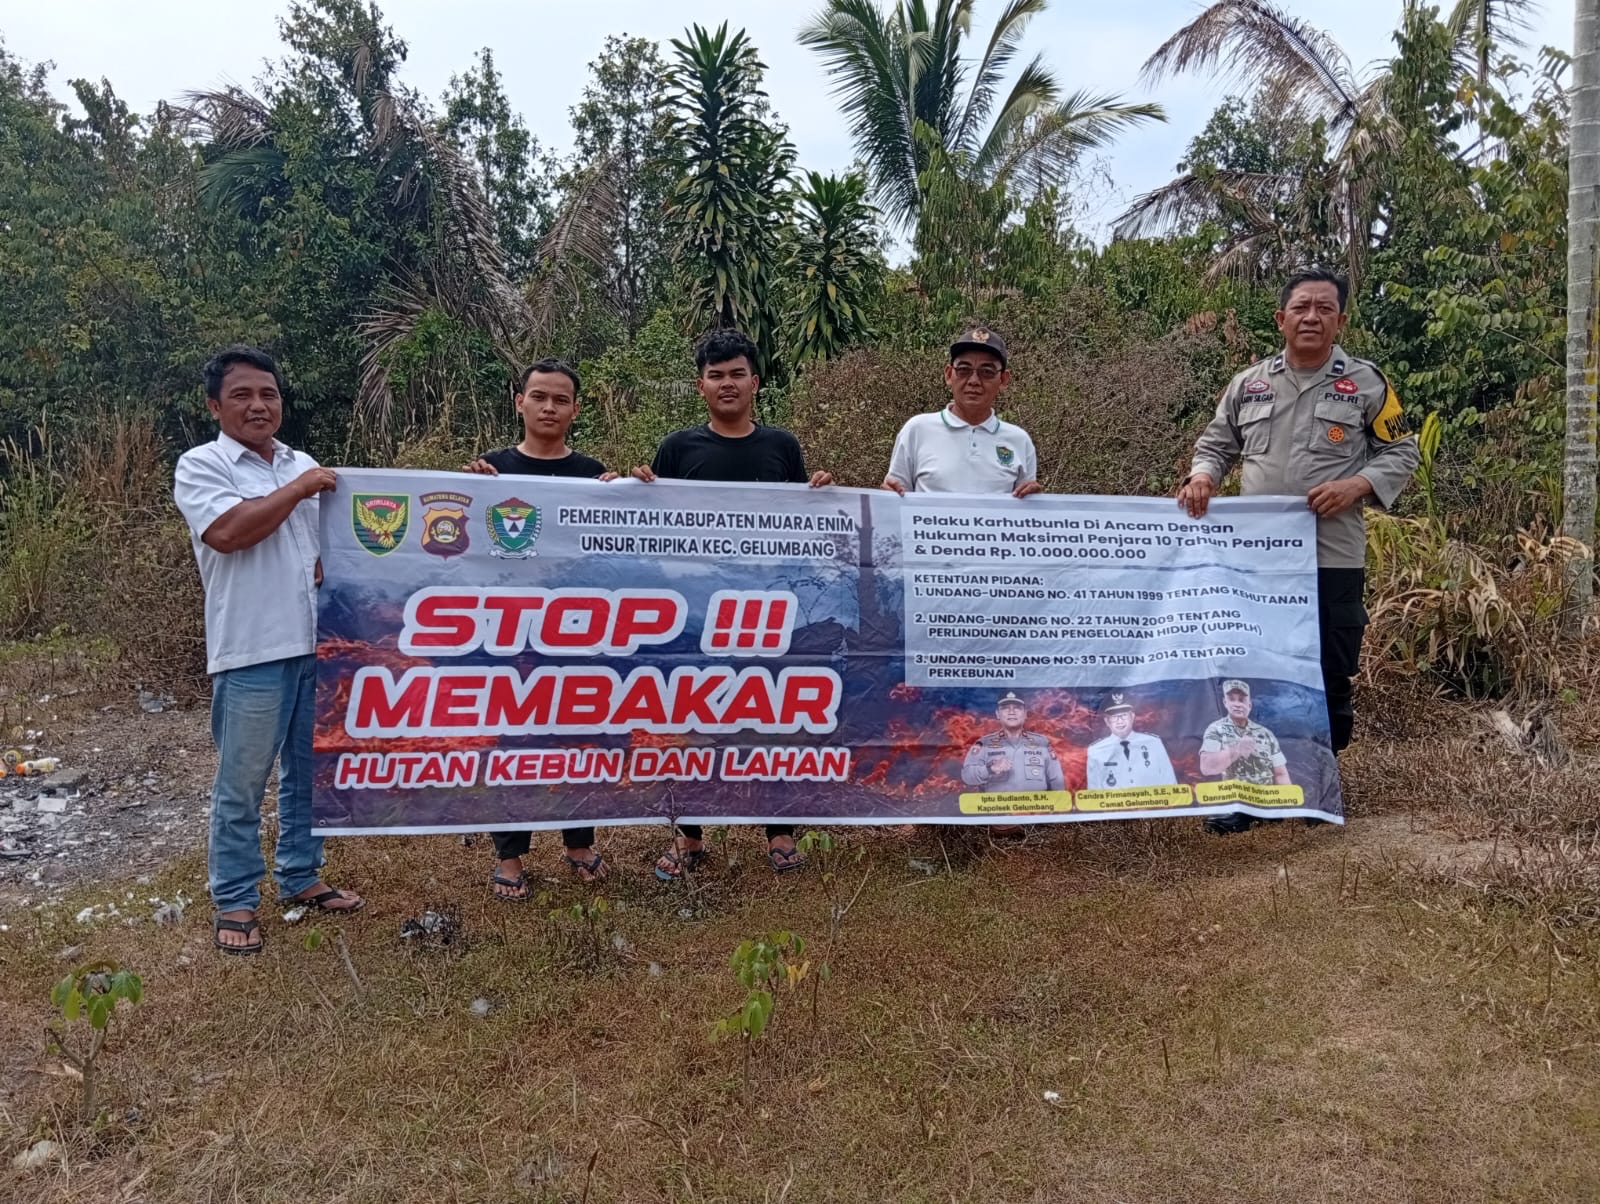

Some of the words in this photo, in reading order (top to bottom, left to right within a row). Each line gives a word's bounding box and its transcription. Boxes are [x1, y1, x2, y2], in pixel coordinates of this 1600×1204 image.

[1324, 392, 1359, 404] POLRI
[559, 508, 660, 527] PEMERINTAH
[663, 511, 755, 529] KABUPATEN
[758, 514, 814, 531] MUARA
[817, 516, 853, 532] ENIM
[912, 515, 970, 527] Pelaku
[1084, 519, 1100, 529] Di
[1104, 520, 1164, 532] Ancam
[1168, 522, 1234, 535] Dengan
[581, 535, 635, 552] UNSUR
[639, 537, 699, 554] TRIPIKA
[702, 539, 737, 554] KEC.
[740, 540, 835, 557] GELUMBANG
[913, 530, 997, 542] Hukuman
[1001, 531, 1084, 543] Maksimal
[1088, 534, 1152, 547] Penjara
[1155, 535, 1172, 546] 10
[1175, 536, 1228, 548] Tahun
[1232, 536, 1304, 550] Penjara
[914, 544, 927, 555] &
[931, 545, 986, 557] Denda
[990, 546, 1017, 560] Rp.
[1020, 546, 1146, 559] 10.000.000.000
[914, 574, 989, 585] KETENTUAN
[991, 575, 1044, 586] PIDANA:
[914, 587, 923, 597] 1.
[926, 588, 1045, 599] UNDANG-UNDANG
[1047, 590, 1070, 600] NO.
[1073, 590, 1087, 599] 41
[1090, 590, 1135, 600] TAHUN
[1137, 591, 1163, 601] 1999
[1167, 586, 1230, 599] TENTANG
[1232, 588, 1308, 605] KEHUTANAN
[408, 594, 680, 648] STOP
[914, 614, 926, 624] 2.
[929, 614, 1048, 625] UNDANG-UNDANG
[1050, 616, 1074, 625] NO.
[1077, 616, 1093, 625] 22
[1095, 616, 1140, 626] TAHUN
[1142, 614, 1174, 626] 2009
[1177, 609, 1241, 622] TENTANG
[929, 628, 1027, 638] PERLINDUNGAN
[1030, 629, 1058, 638] DAN
[1061, 629, 1154, 639] PENGELOLAAN
[1157, 624, 1199, 637] HIDUP
[1201, 622, 1263, 637] (UUPPLH)
[915, 655, 927, 664] 3.
[929, 655, 1051, 665] UNDANG-UNDANG
[1053, 656, 1078, 665] NO.
[1080, 655, 1097, 664] 39
[1099, 656, 1145, 666] TAHUN
[1148, 650, 1179, 662] 2014
[1181, 647, 1247, 659] TENTANG
[929, 668, 1014, 679] PERKEBUNAN
[353, 674, 840, 730] MEMBAKAR
[337, 754, 476, 786] HUTAN
[489, 752, 622, 781] KEBUN
[633, 750, 712, 778] DAN
[722, 750, 850, 779] LAHAN
[981, 795, 995, 803] Iptu
[997, 795, 1032, 803] Budianto,
[1077, 792, 1104, 800] Candra
[1125, 799, 1169, 807] Gelumbang
[1202, 793, 1237, 802] Danramil
[1012, 804, 1055, 812] Gelumbang
